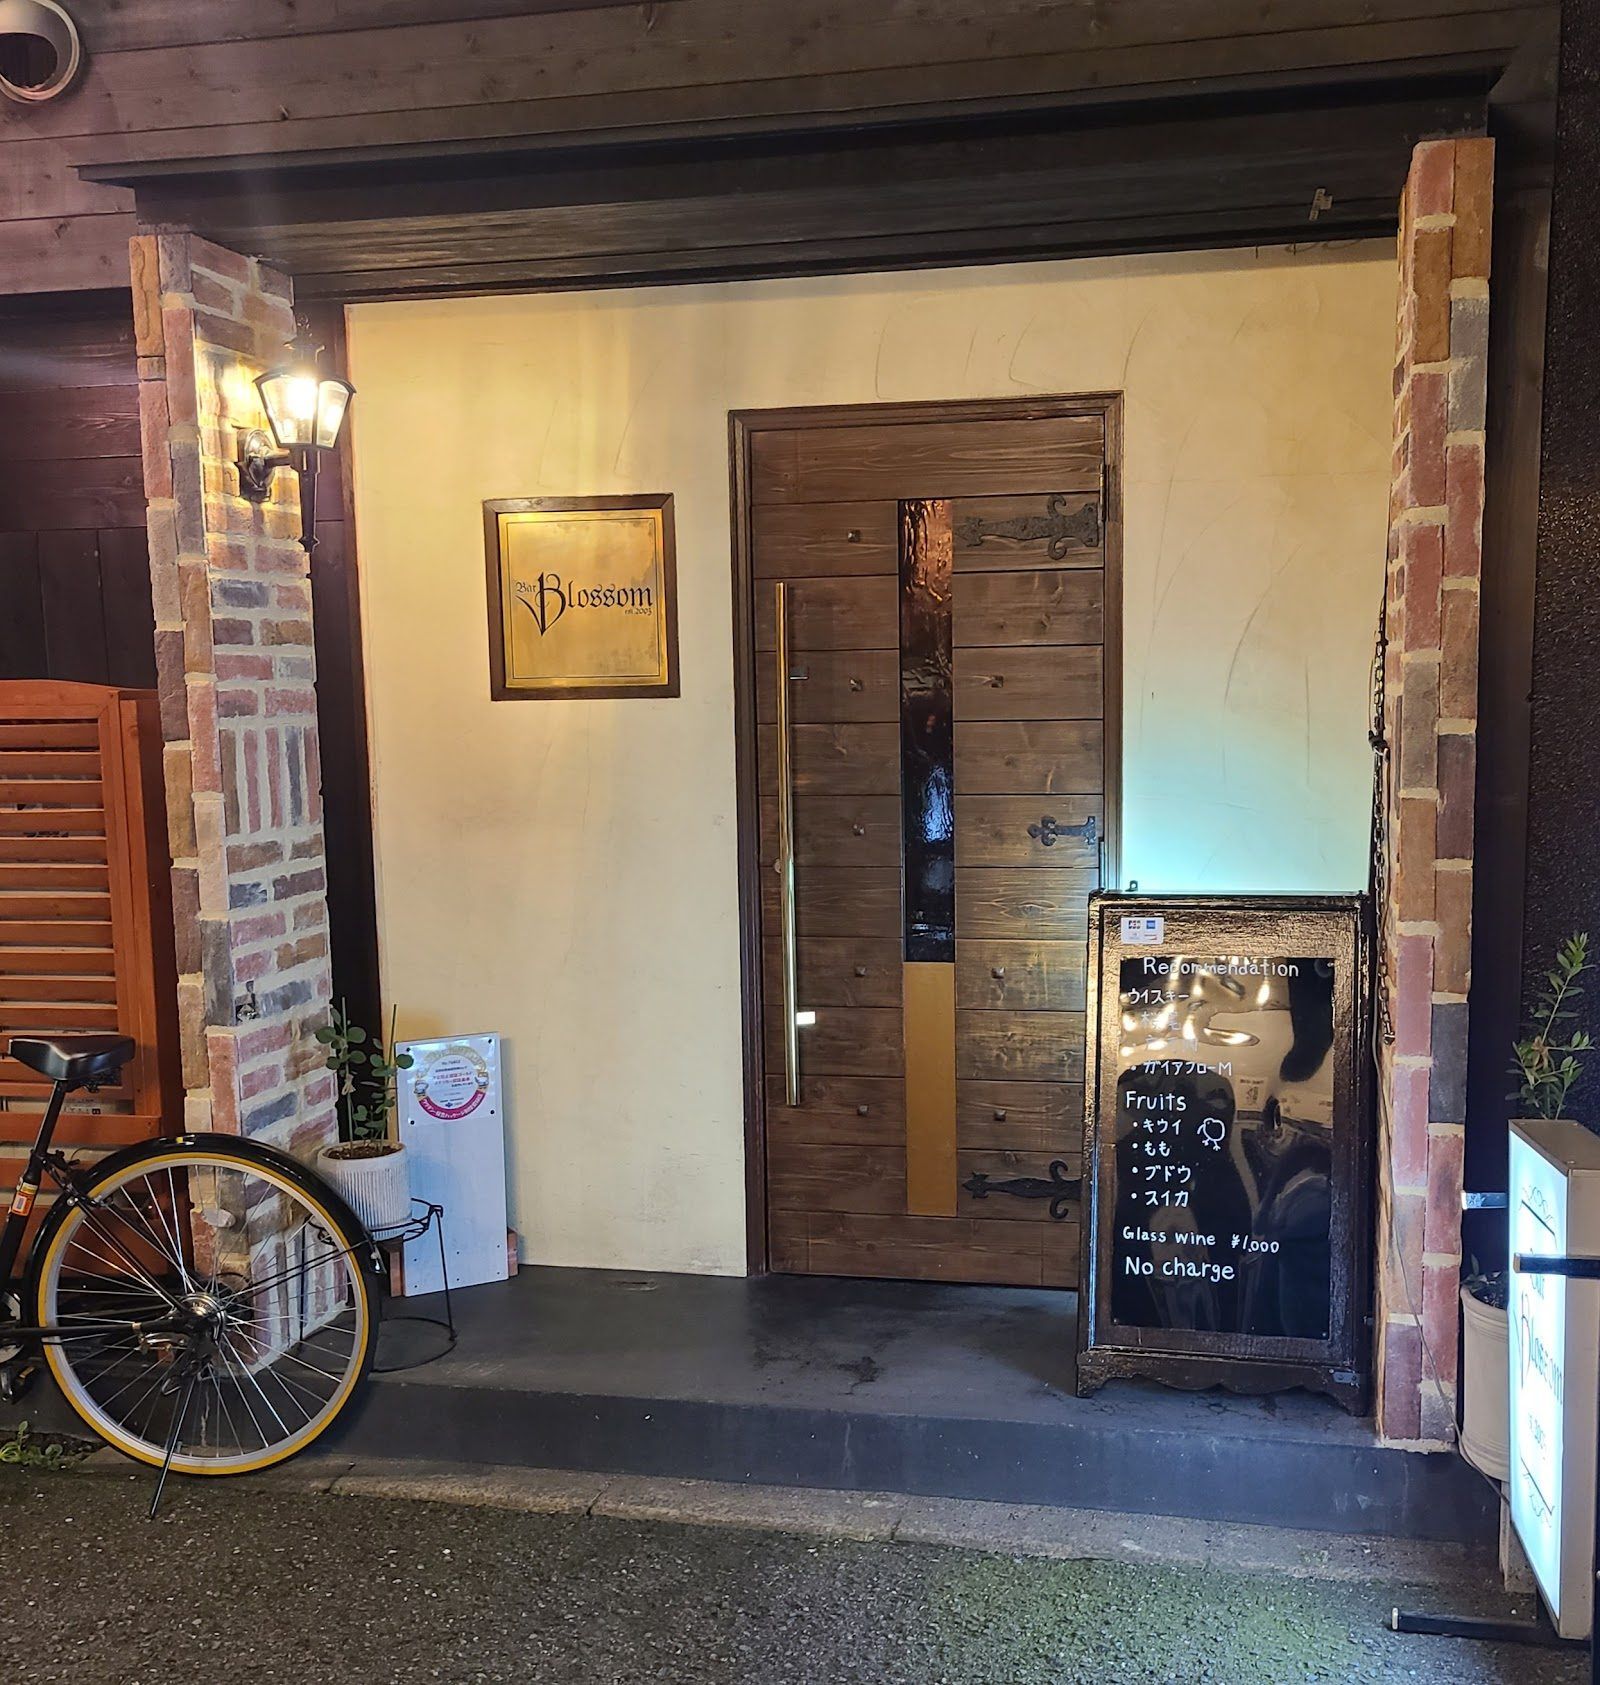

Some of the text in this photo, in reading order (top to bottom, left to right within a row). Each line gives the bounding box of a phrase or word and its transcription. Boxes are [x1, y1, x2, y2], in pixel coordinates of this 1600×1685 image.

[515, 572, 653, 636] Bar Blossom
[1143, 956, 1299, 977] Recommendation
[1127, 987, 1190, 1005] ウイスキー
[1125, 1090, 1187, 1112] Fruits
[1143, 1118, 1182, 1136] キウイ
[1144, 1141, 1171, 1157] もも
[1144, 1165, 1192, 1184] ブドウ
[1144, 1190, 1189, 1208] スイカ
[1122, 1226, 1167, 1244] Glass
[1175, 1231, 1217, 1246] wine
[1125, 1256, 1236, 1283] No charge
